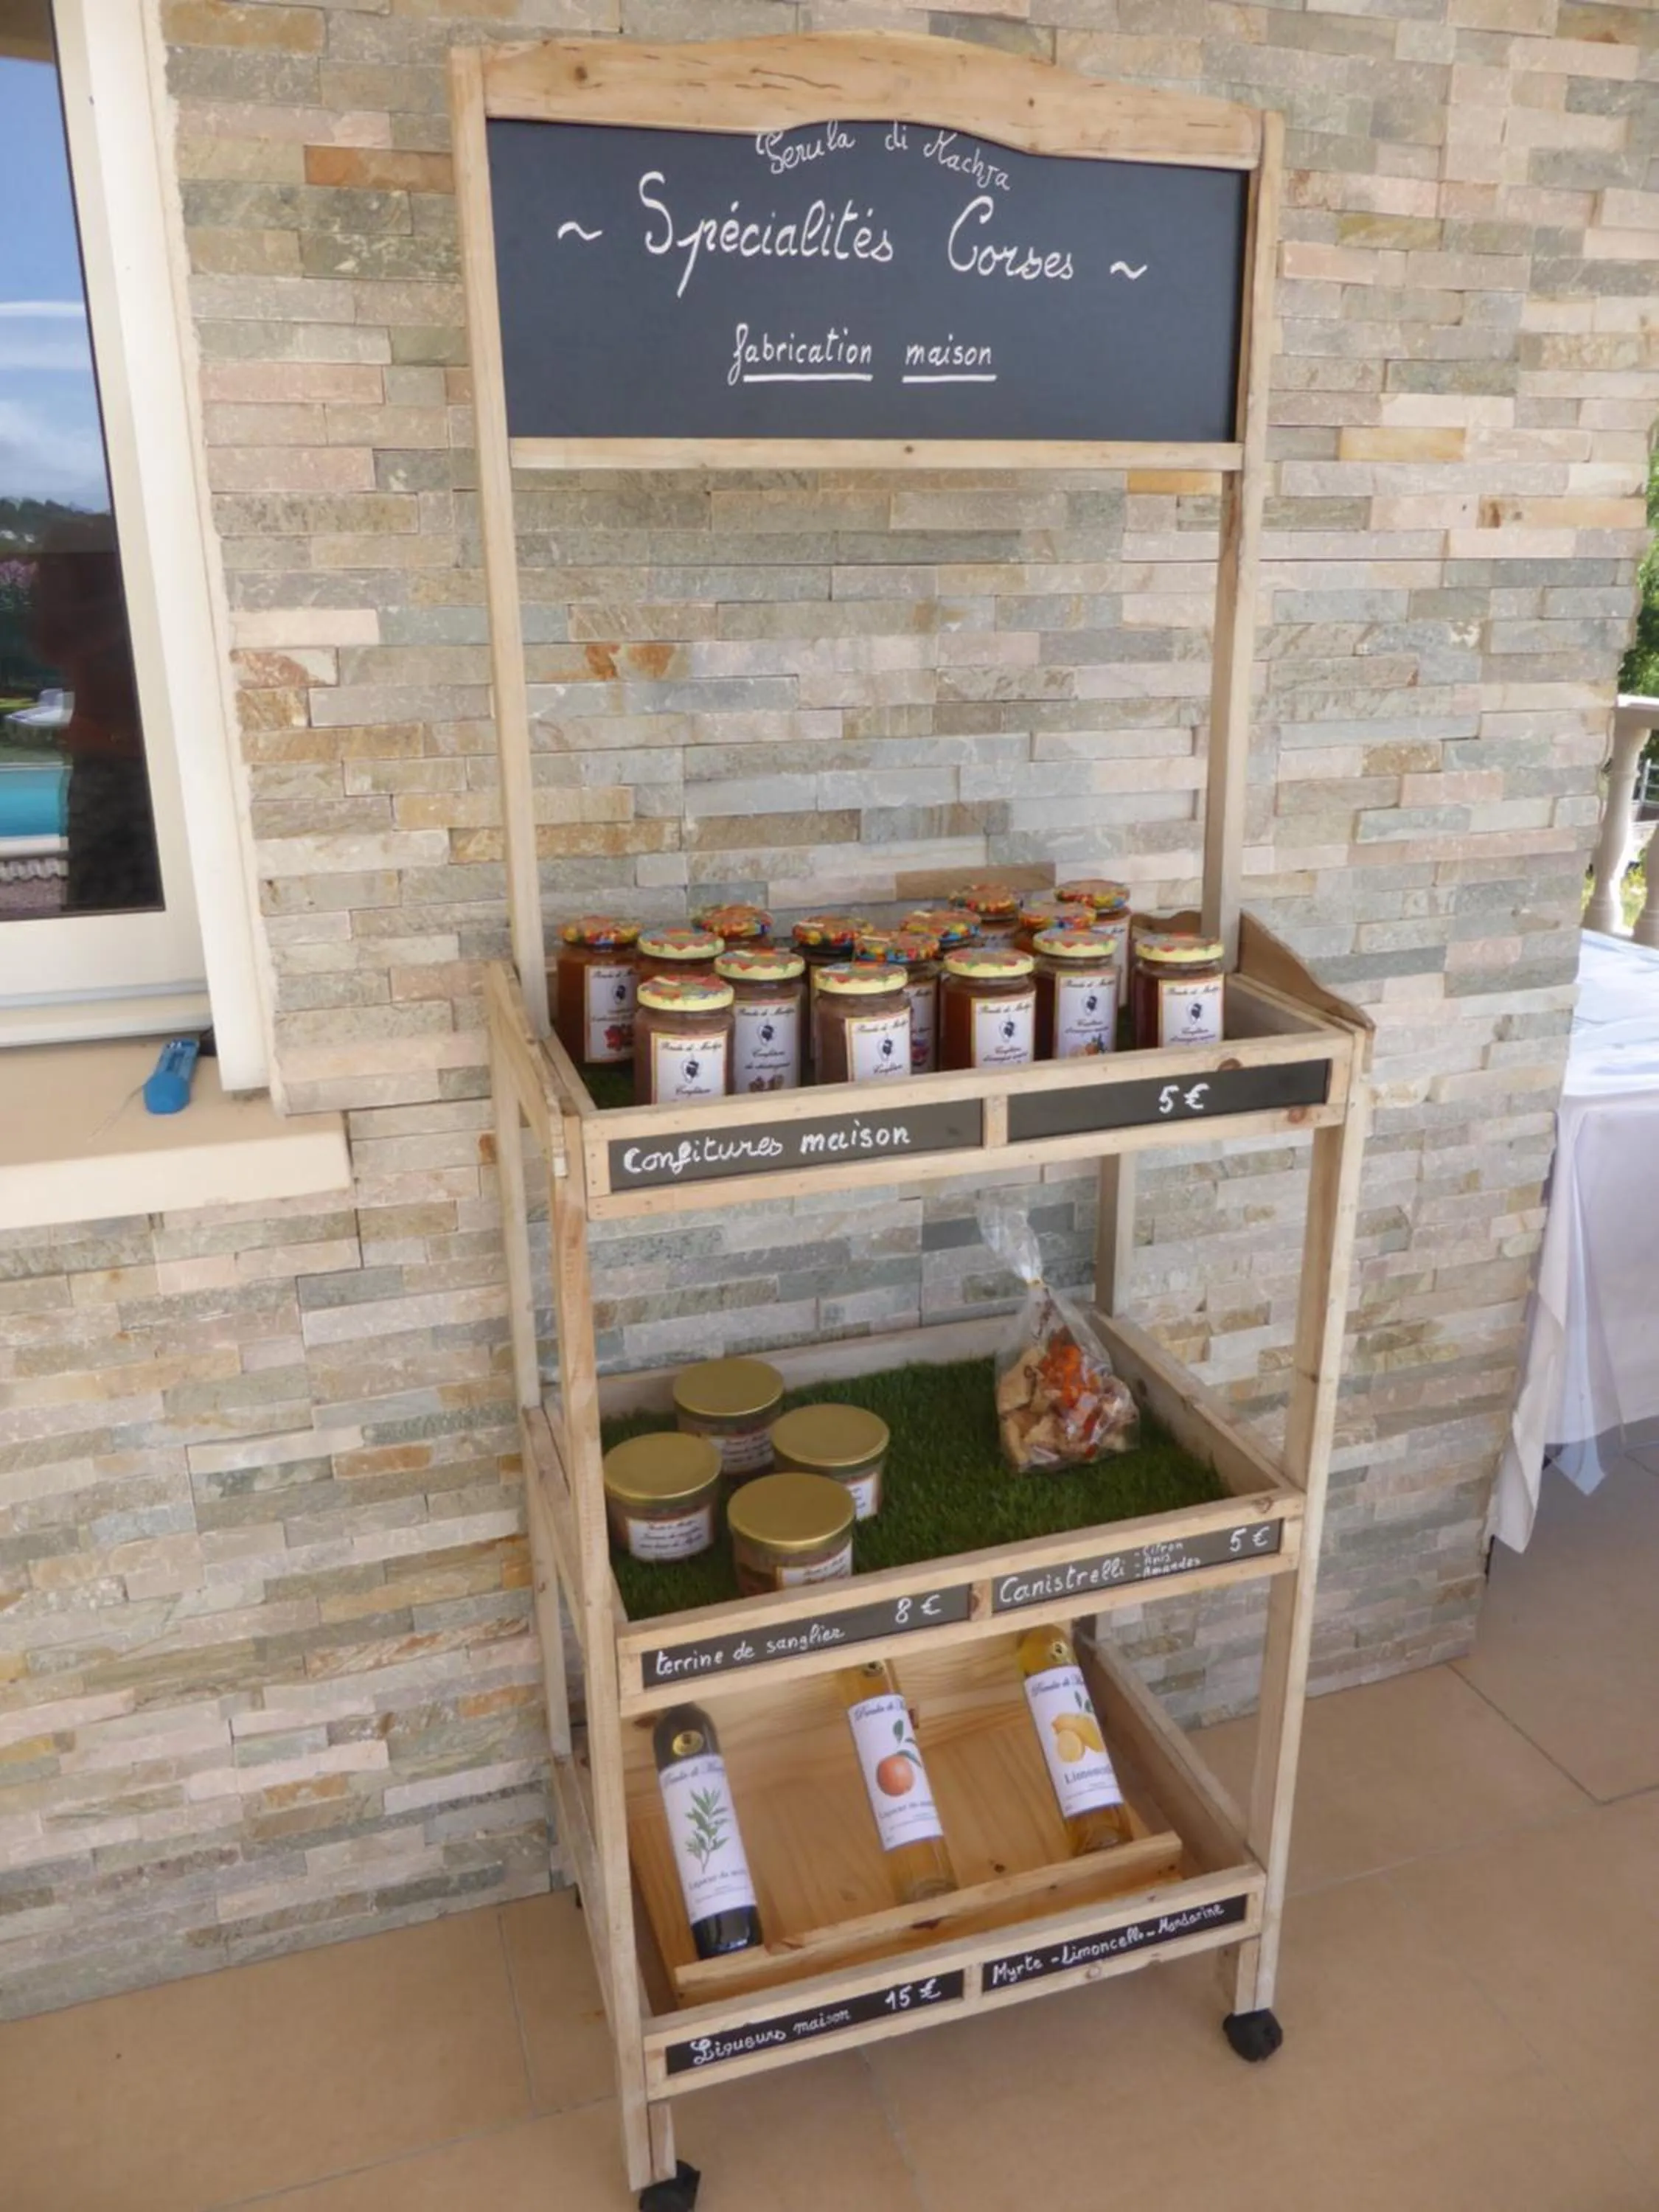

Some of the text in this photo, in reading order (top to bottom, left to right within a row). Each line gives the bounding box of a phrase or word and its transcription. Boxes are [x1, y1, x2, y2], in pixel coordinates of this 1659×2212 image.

[639, 170, 1074, 298] Spécialités Corses
[727, 323, 992, 386] fabrication maison
[623, 1082, 1211, 1175] Confitures maison 5 €
[999, 1525, 1271, 1603] Canistrelli 5 €
[732, 1641, 755, 1660] de
[894, 1597, 912, 1623] 8
[920, 1594, 942, 1616] €
[793, 2007, 852, 2035] maison
[885, 1986, 911, 2011] 15
[919, 1977, 942, 1999] €
